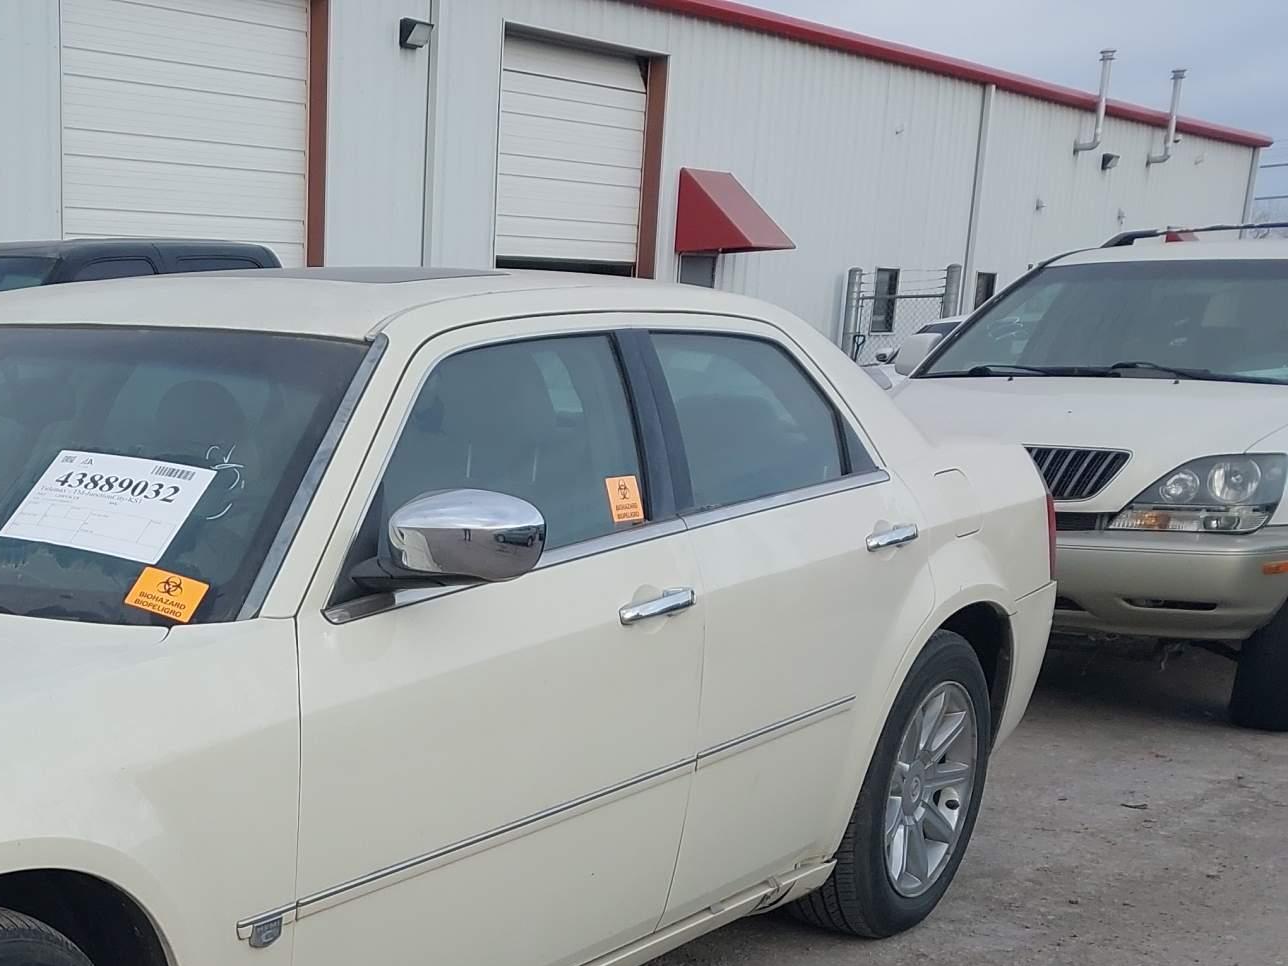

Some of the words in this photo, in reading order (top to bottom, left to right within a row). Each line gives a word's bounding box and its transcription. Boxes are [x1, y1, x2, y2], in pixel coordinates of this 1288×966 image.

[55, 471, 181, 503] 43889032
[134, 598, 183, 618] BIOPELIGRO
[139, 591, 187, 611] BIOHAZARD
